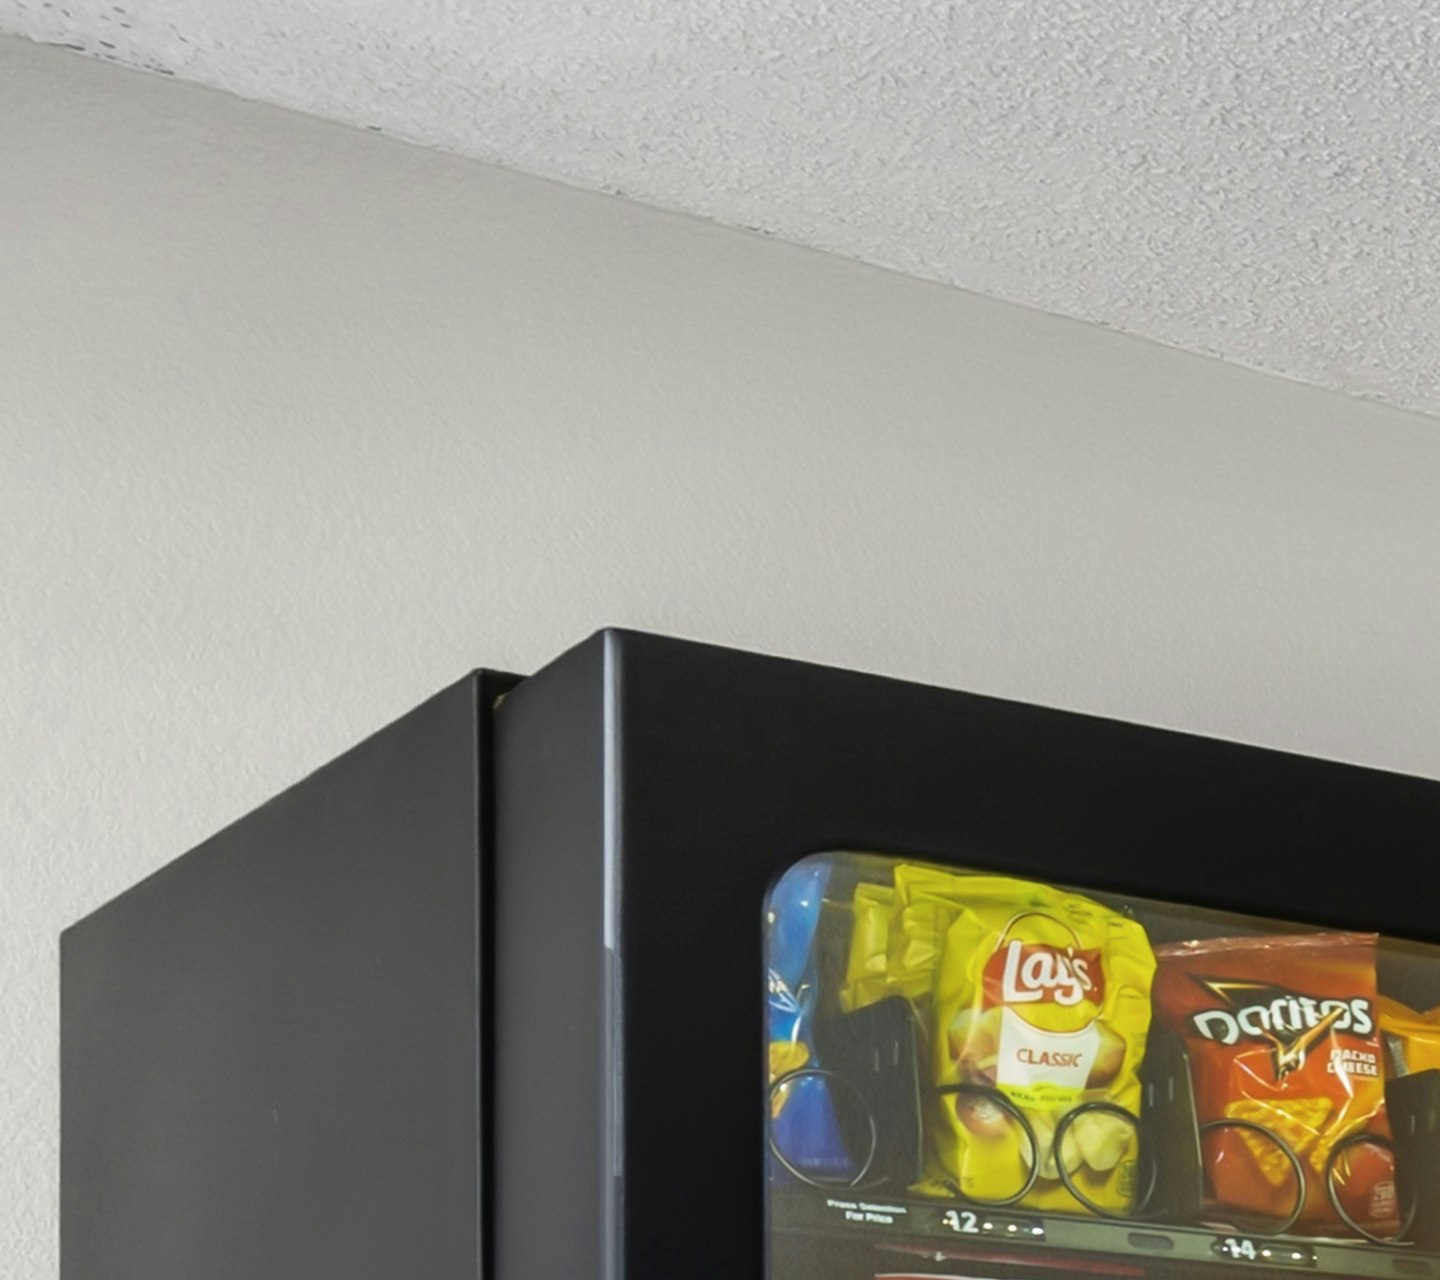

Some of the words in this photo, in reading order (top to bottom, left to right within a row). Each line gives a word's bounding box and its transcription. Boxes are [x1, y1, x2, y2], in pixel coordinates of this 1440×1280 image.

[1002, 940, 1093, 1006] Lay's
[1016, 1049, 1083, 1067] CLASSIC
[946, 1210, 979, 1233] 12
[1225, 1238, 1256, 1260] 14
